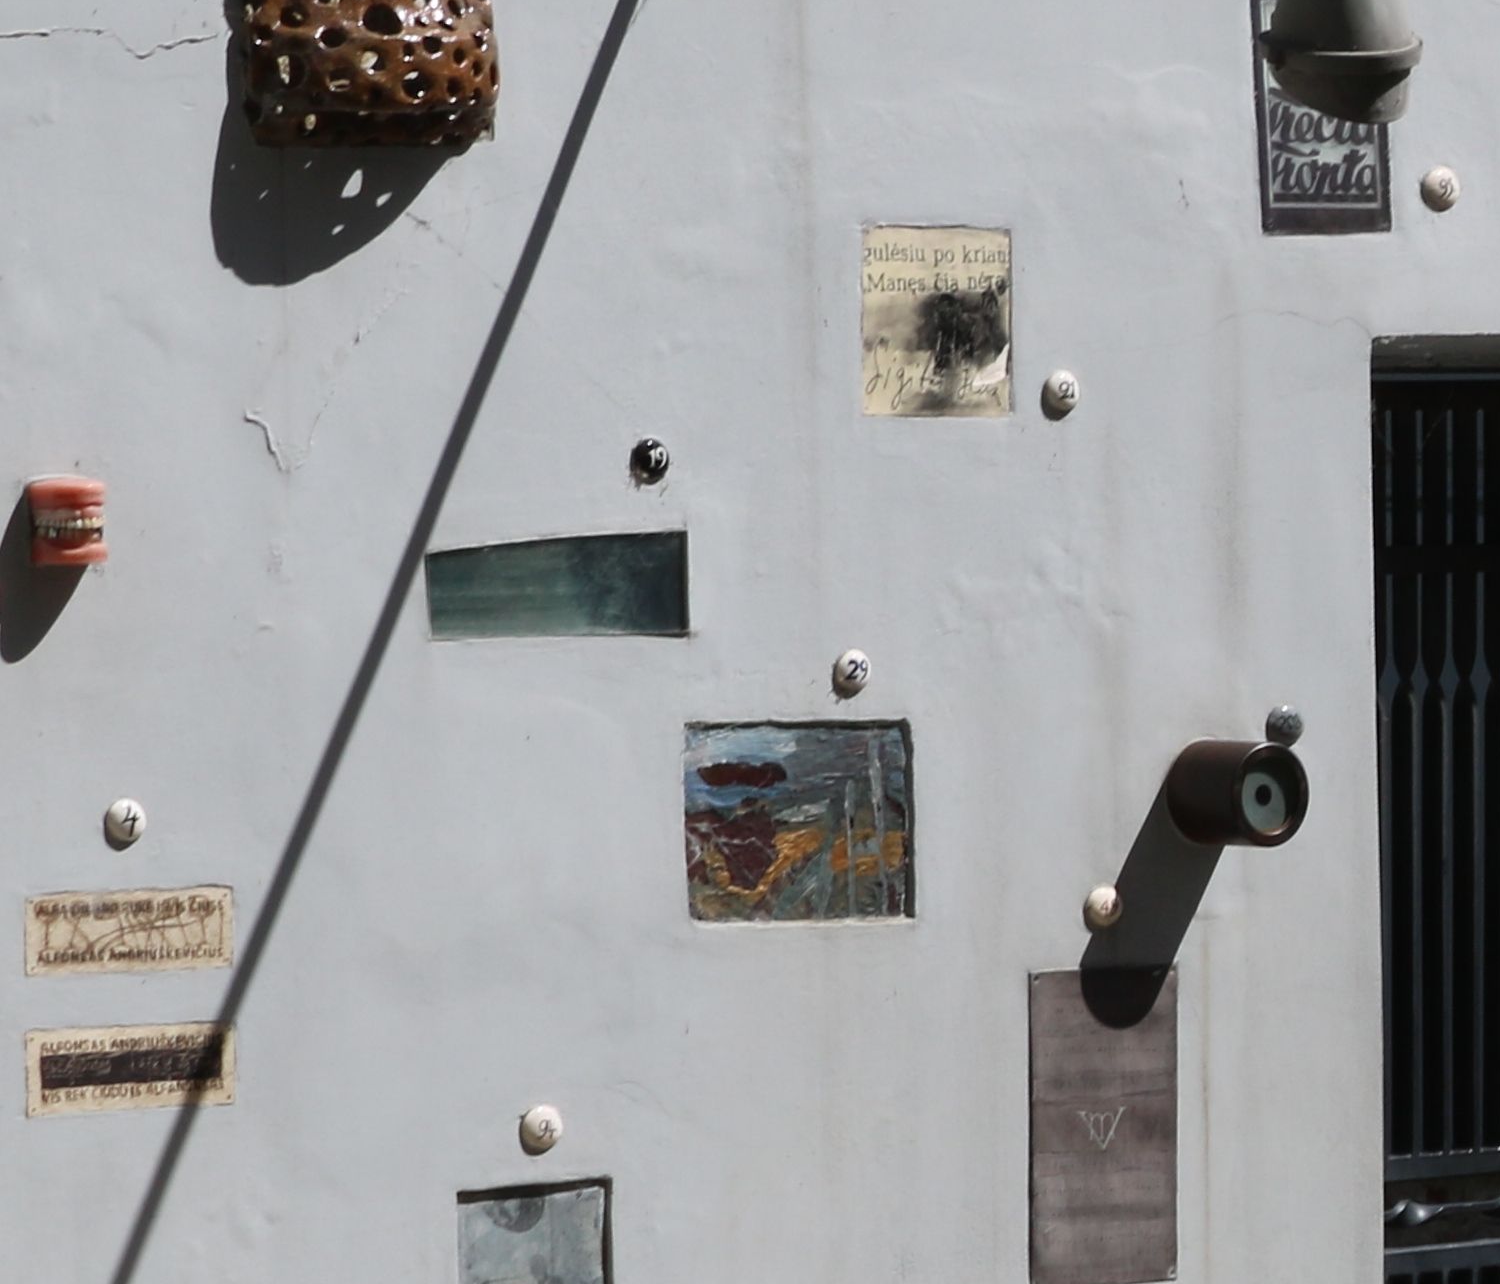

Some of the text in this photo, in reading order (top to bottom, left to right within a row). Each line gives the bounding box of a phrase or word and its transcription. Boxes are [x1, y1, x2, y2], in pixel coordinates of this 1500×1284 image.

[934, 248, 956, 267] po
[1058, 381, 1076, 401] 21
[649, 445, 668, 470] 19
[844, 659, 868, 682] 29
[122, 805, 141, 838] 4
